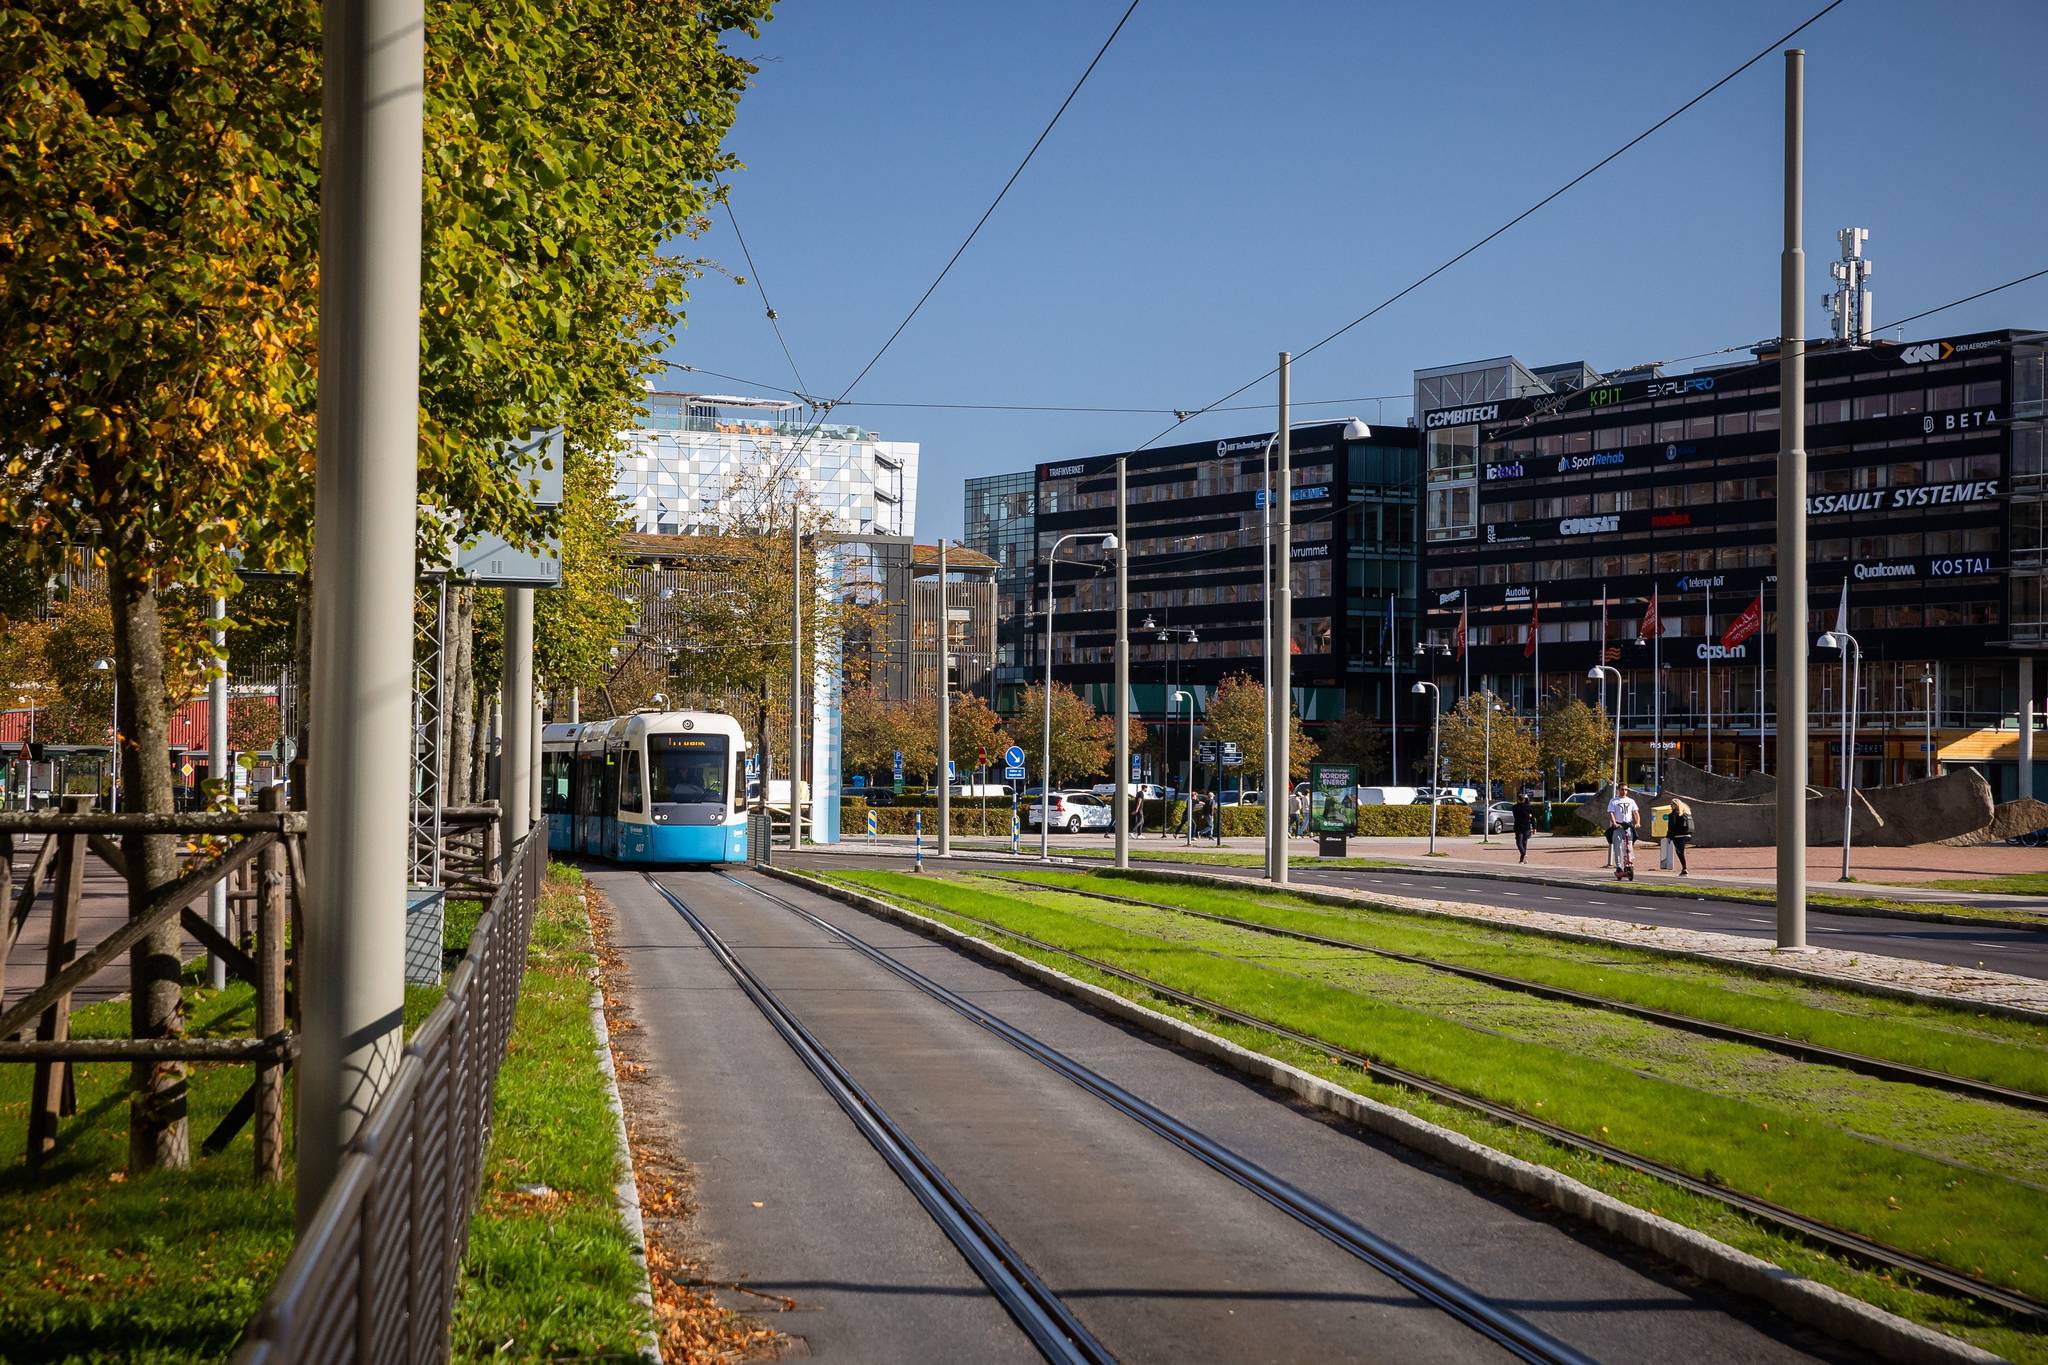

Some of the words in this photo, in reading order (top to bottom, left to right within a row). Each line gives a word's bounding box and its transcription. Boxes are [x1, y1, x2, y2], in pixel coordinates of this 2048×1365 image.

[1590, 387, 1622, 407] KPIT
[1426, 404, 1499, 428] COMBITECH
[1945, 410, 1996, 430] BETA
[1571, 451, 1625, 470] SportRehab
[1049, 464, 1084, 477] TRAFIKVERKET
[1486, 461, 1523, 480] ictech
[1805, 491, 1885, 514] ASSAULT
[1892, 480, 1999, 508] SYSTEMES
[1652, 511, 1691, 528] molex
[1289, 543, 1329, 558] lvrummet
[1854, 562, 1916, 580] Qualcomm
[1440, 589, 1461, 605] Berge
[1505, 586, 1531, 597] Autoliv
[1320, 772, 1350, 780] NORDISK
